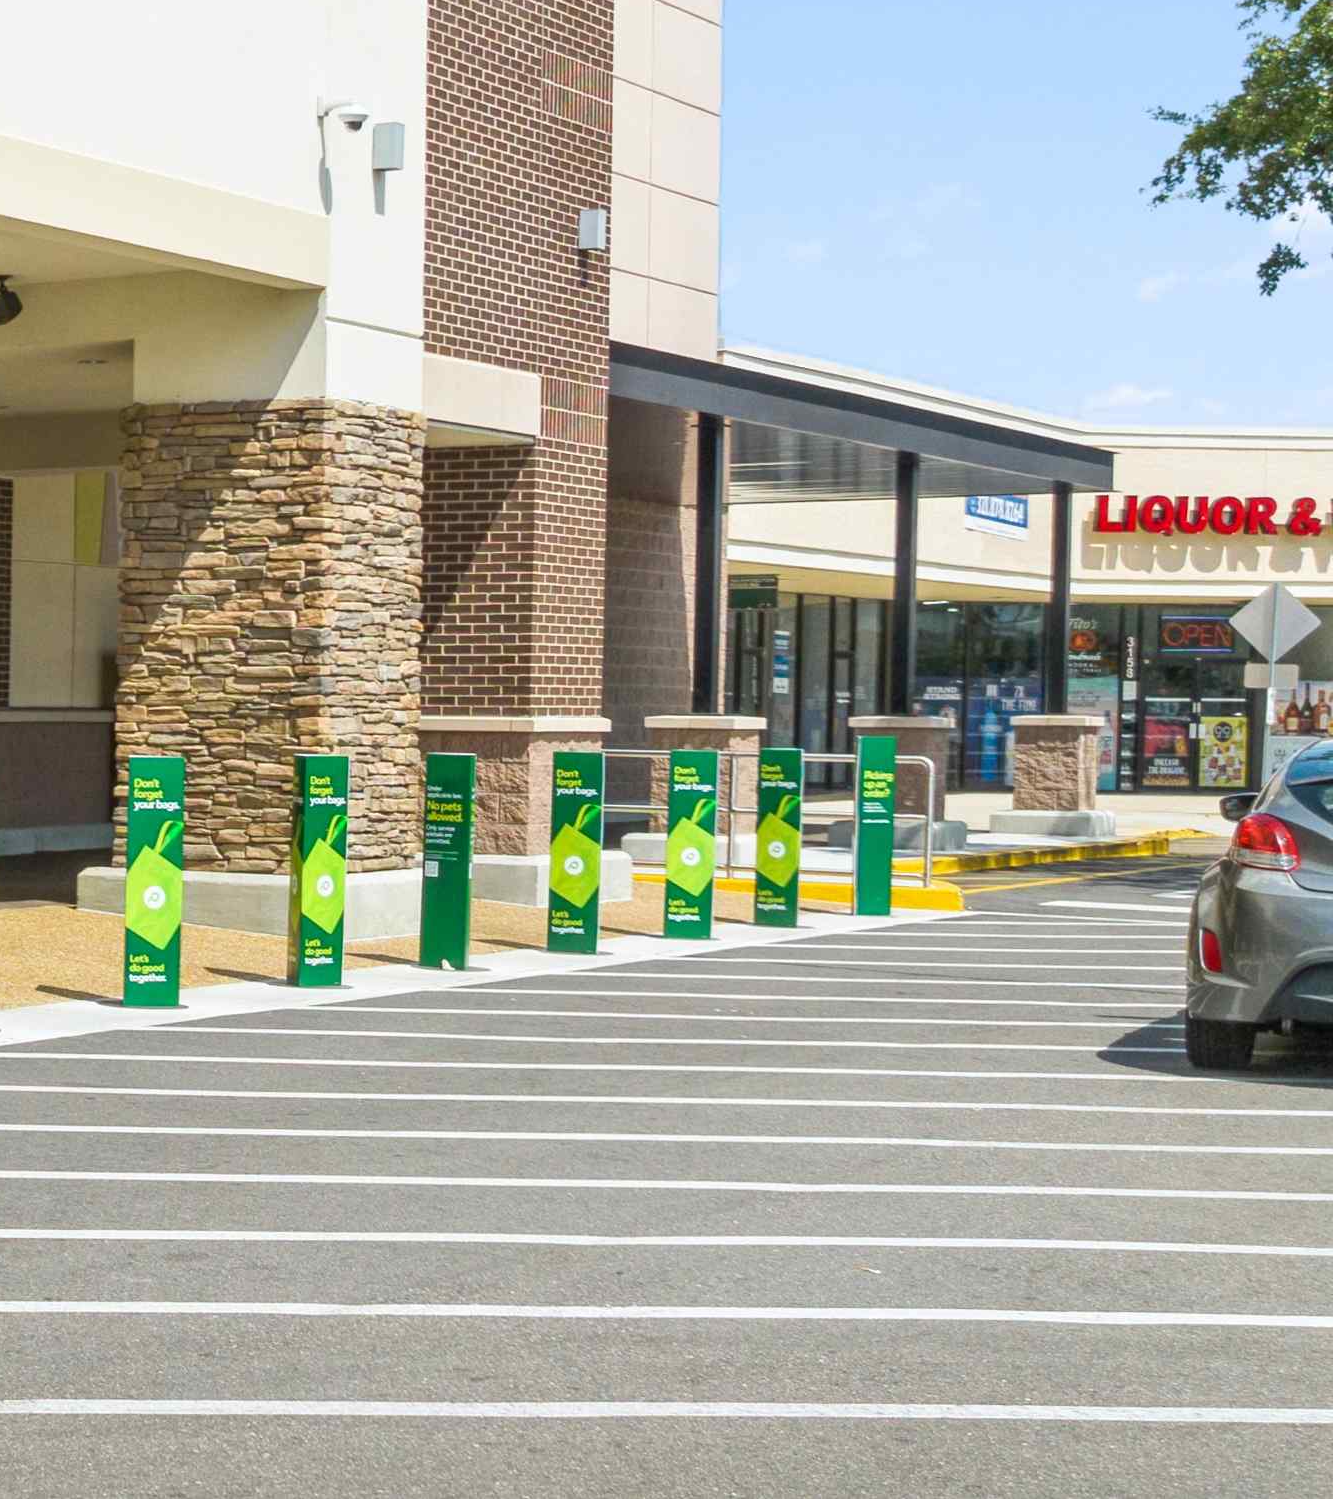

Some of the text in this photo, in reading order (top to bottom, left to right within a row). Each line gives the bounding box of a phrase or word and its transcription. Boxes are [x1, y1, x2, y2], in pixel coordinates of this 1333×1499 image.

[1094, 495, 1322, 537] LIQUOR &
[1161, 623, 1233, 647] OPEN
